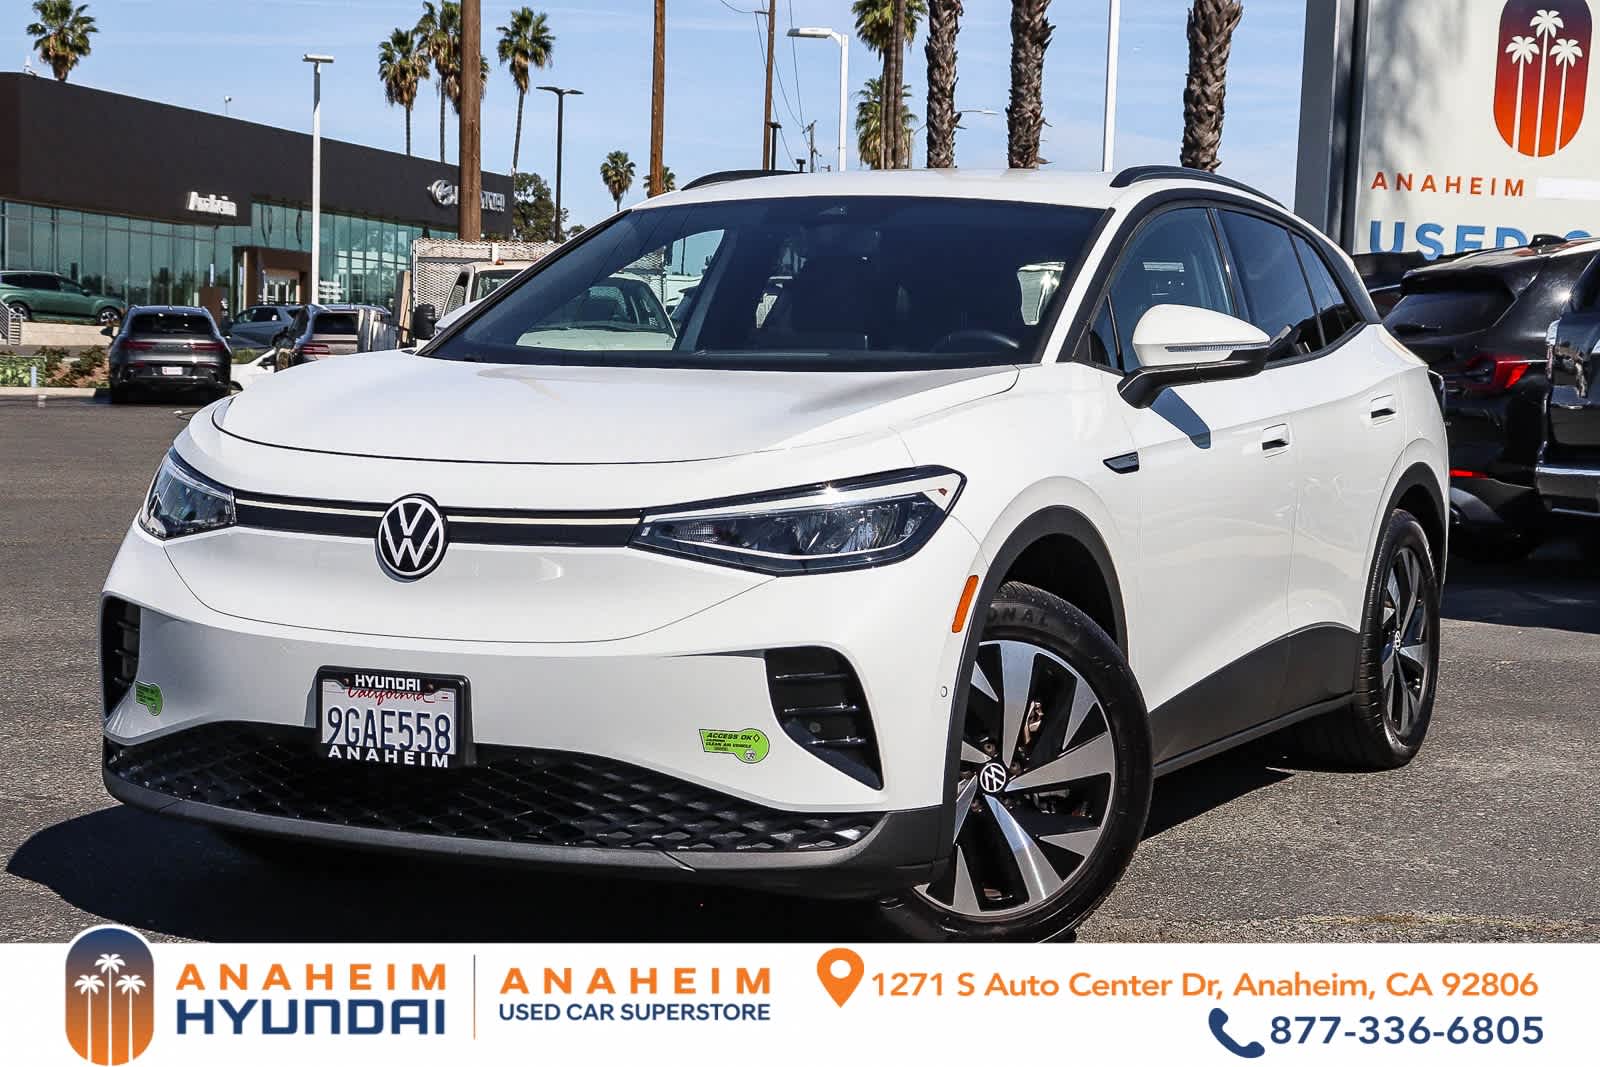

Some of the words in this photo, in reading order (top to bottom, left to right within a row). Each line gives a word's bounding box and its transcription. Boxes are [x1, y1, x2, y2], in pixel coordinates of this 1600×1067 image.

[1371, 171, 1525, 197] ANAHEIM
[355, 674, 421, 691] HYUNDAI
[327, 706, 450, 753] 9GAE558
[328, 745, 448, 769] ANAHEIM
